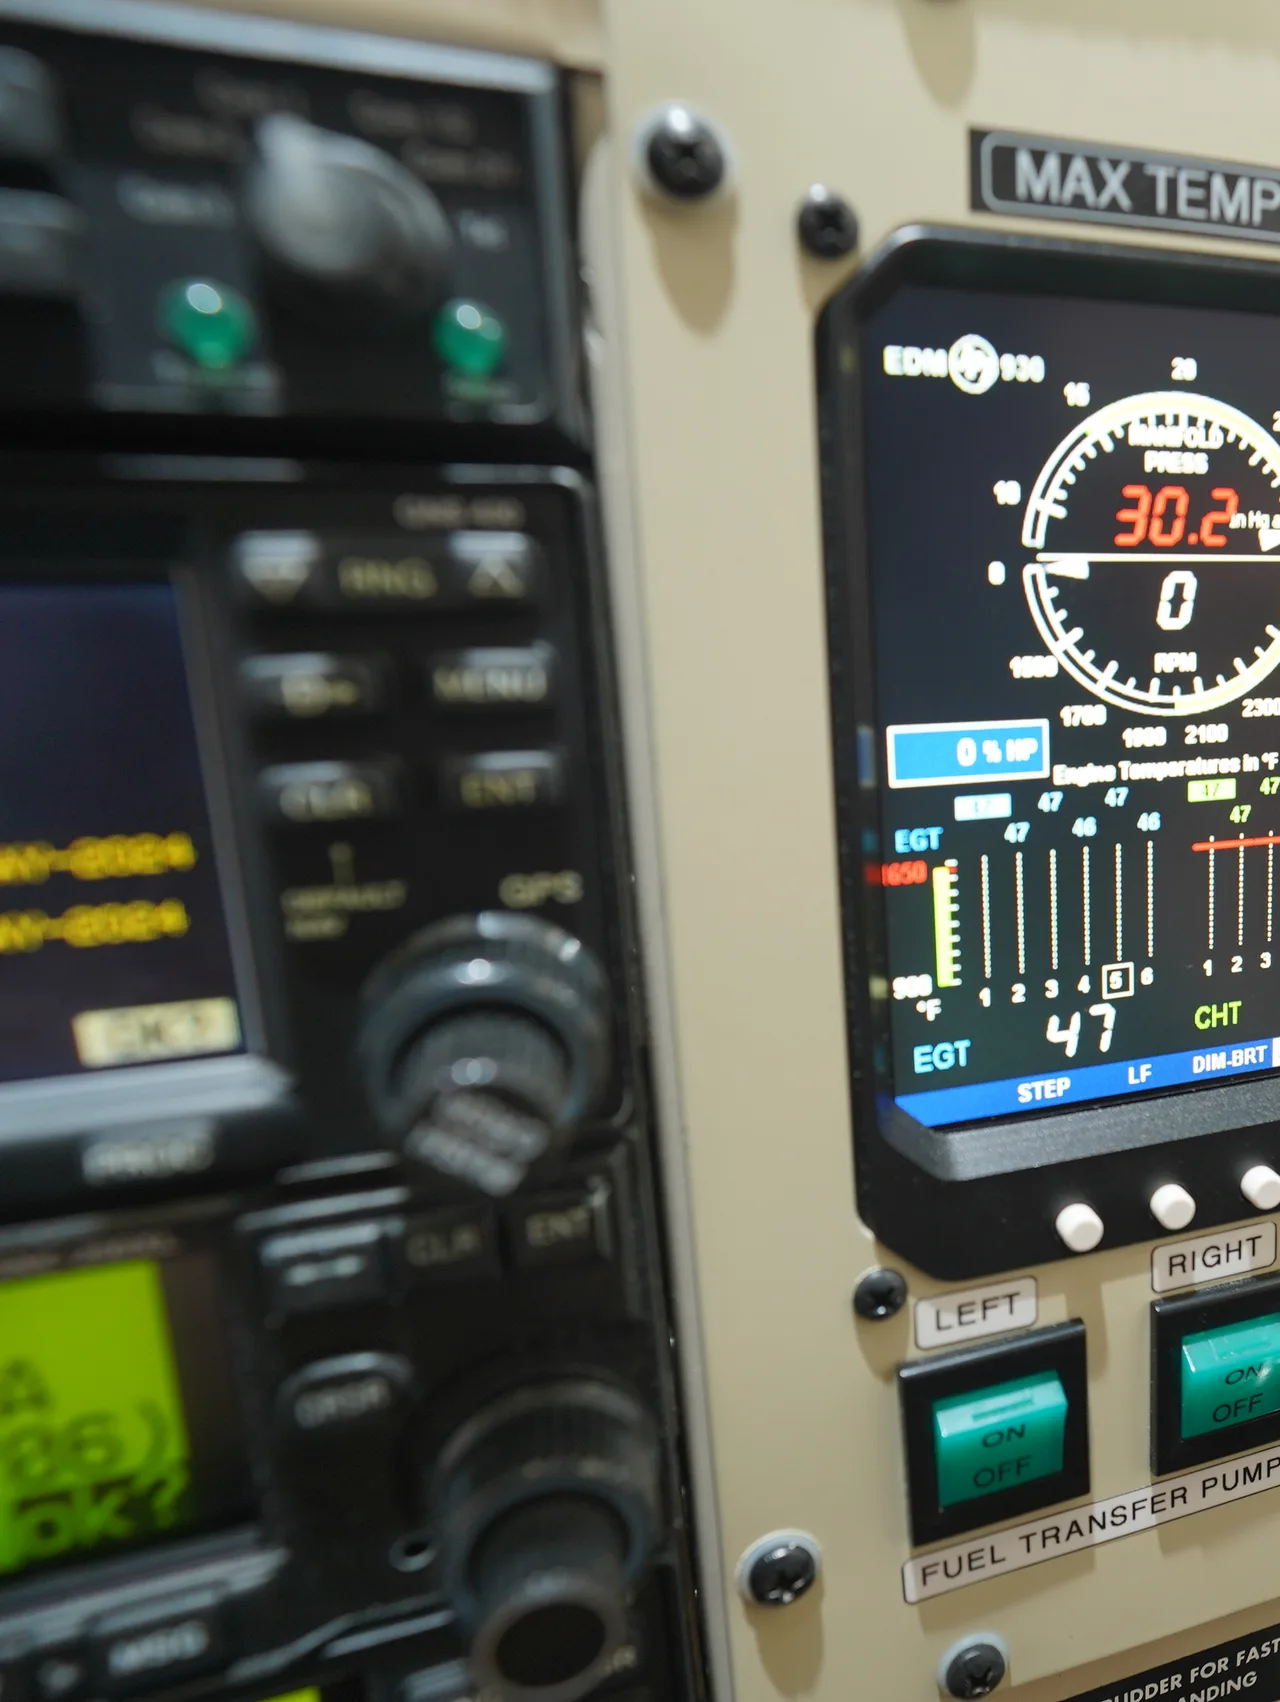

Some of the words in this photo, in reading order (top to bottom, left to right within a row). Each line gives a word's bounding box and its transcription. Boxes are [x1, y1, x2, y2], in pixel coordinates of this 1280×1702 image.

[1015, 149, 1132, 212] MAX
[883, 345, 948, 378] EDM
[1114, 484, 1239, 547] 30.2
[1156, 570, 1197, 630] 0
[1154, 652, 1196, 673] RPM
[957, 737, 977, 767] 0
[1242, 754, 1259, 772] in
[1260, 776, 1280, 795] 47
[1230, 804, 1251, 823] 47
[895, 826, 944, 853] EGT
[1194, 1001, 1242, 1030] CHT
[914, 1039, 971, 1074] EGT
[1046, 1002, 1116, 1058] 47
[1018, 1077, 1071, 1103] STEP
[1128, 1064, 1152, 1084] LF
[1193, 1045, 1268, 1074] DIM-BRT
[1169, 1235, 1263, 1276] RIGHT
[935, 1293, 1020, 1331] LEFT
[1213, 1393, 1263, 1423] OFF
[982, 1425, 1026, 1448] ON
[973, 1455, 1031, 1488] OFF
[921, 1545, 1006, 1587] FUEL
[1019, 1487, 1188, 1553] TRANSFER
[1102, 1674, 1182, 1702] UDDER
[1190, 1657, 1229, 1684] FOR
